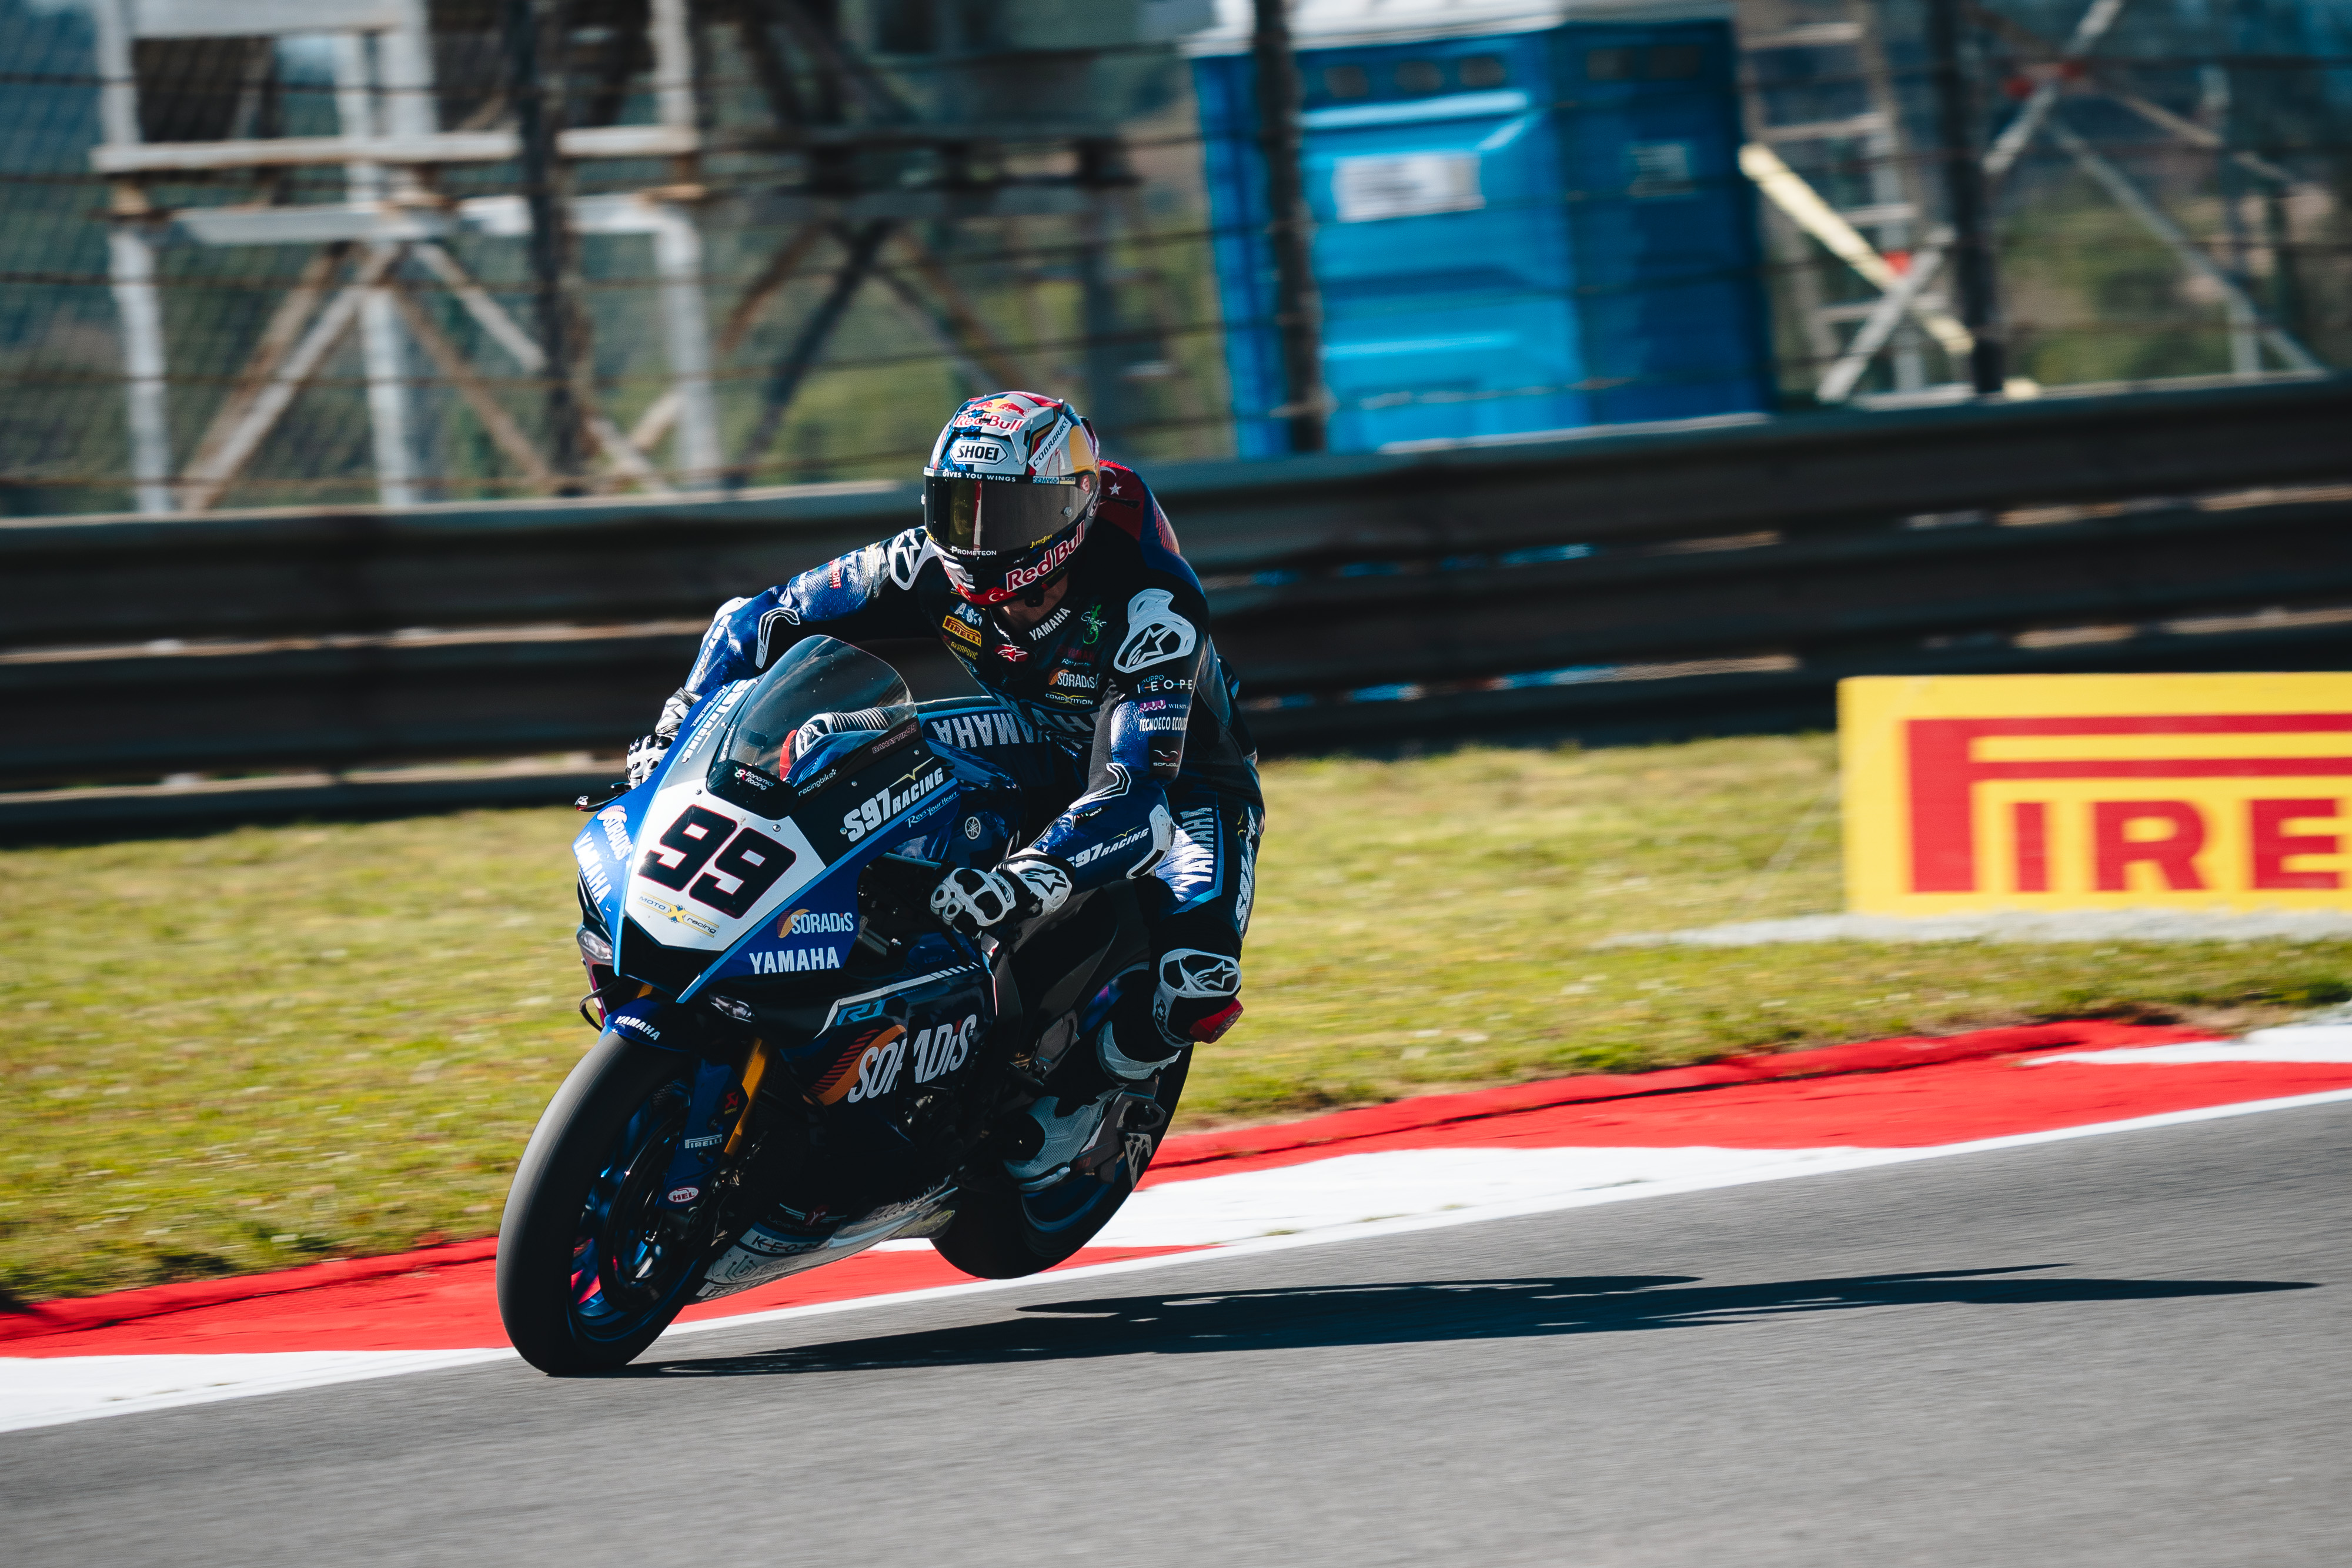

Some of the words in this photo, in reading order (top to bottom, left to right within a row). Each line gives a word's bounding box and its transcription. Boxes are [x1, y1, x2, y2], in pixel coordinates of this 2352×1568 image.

[953, 413, 987, 427] Red
[987, 414, 1024, 432] Bull
[957, 444, 1000, 461] SHOEI
[950, 546, 997, 556] PROMETEON
[1006, 549, 1053, 592] Red
[1054, 520, 1085, 567] Bull
[944, 617, 981, 645] PIRELLI
[1029, 607, 1071, 641] YAMAHA
[1045, 693, 1093, 705] COMPETITION
[1139, 717, 1171, 731] TECNOECO
[745, 777, 767, 790] Racing
[798, 771, 834, 796] racingbike
[905, 810, 927, 828] Revs
[926, 801, 941, 816] Your
[941, 791, 957, 805] Heart
[1179, 807, 1214, 888] YAMAHA
[573, 831, 612, 904] YAMAHA
[637, 804, 797, 919] 99
[639, 896, 666, 910] MOTO
[687, 917, 717, 934] racing
[749, 947, 840, 974] YAMAHA
[836, 999, 886, 1026] R1
[614, 1015, 660, 1041] YAMAHA
[684, 1134, 723, 1149] PIRELLI
[673, 1192, 695, 1201] HEL
